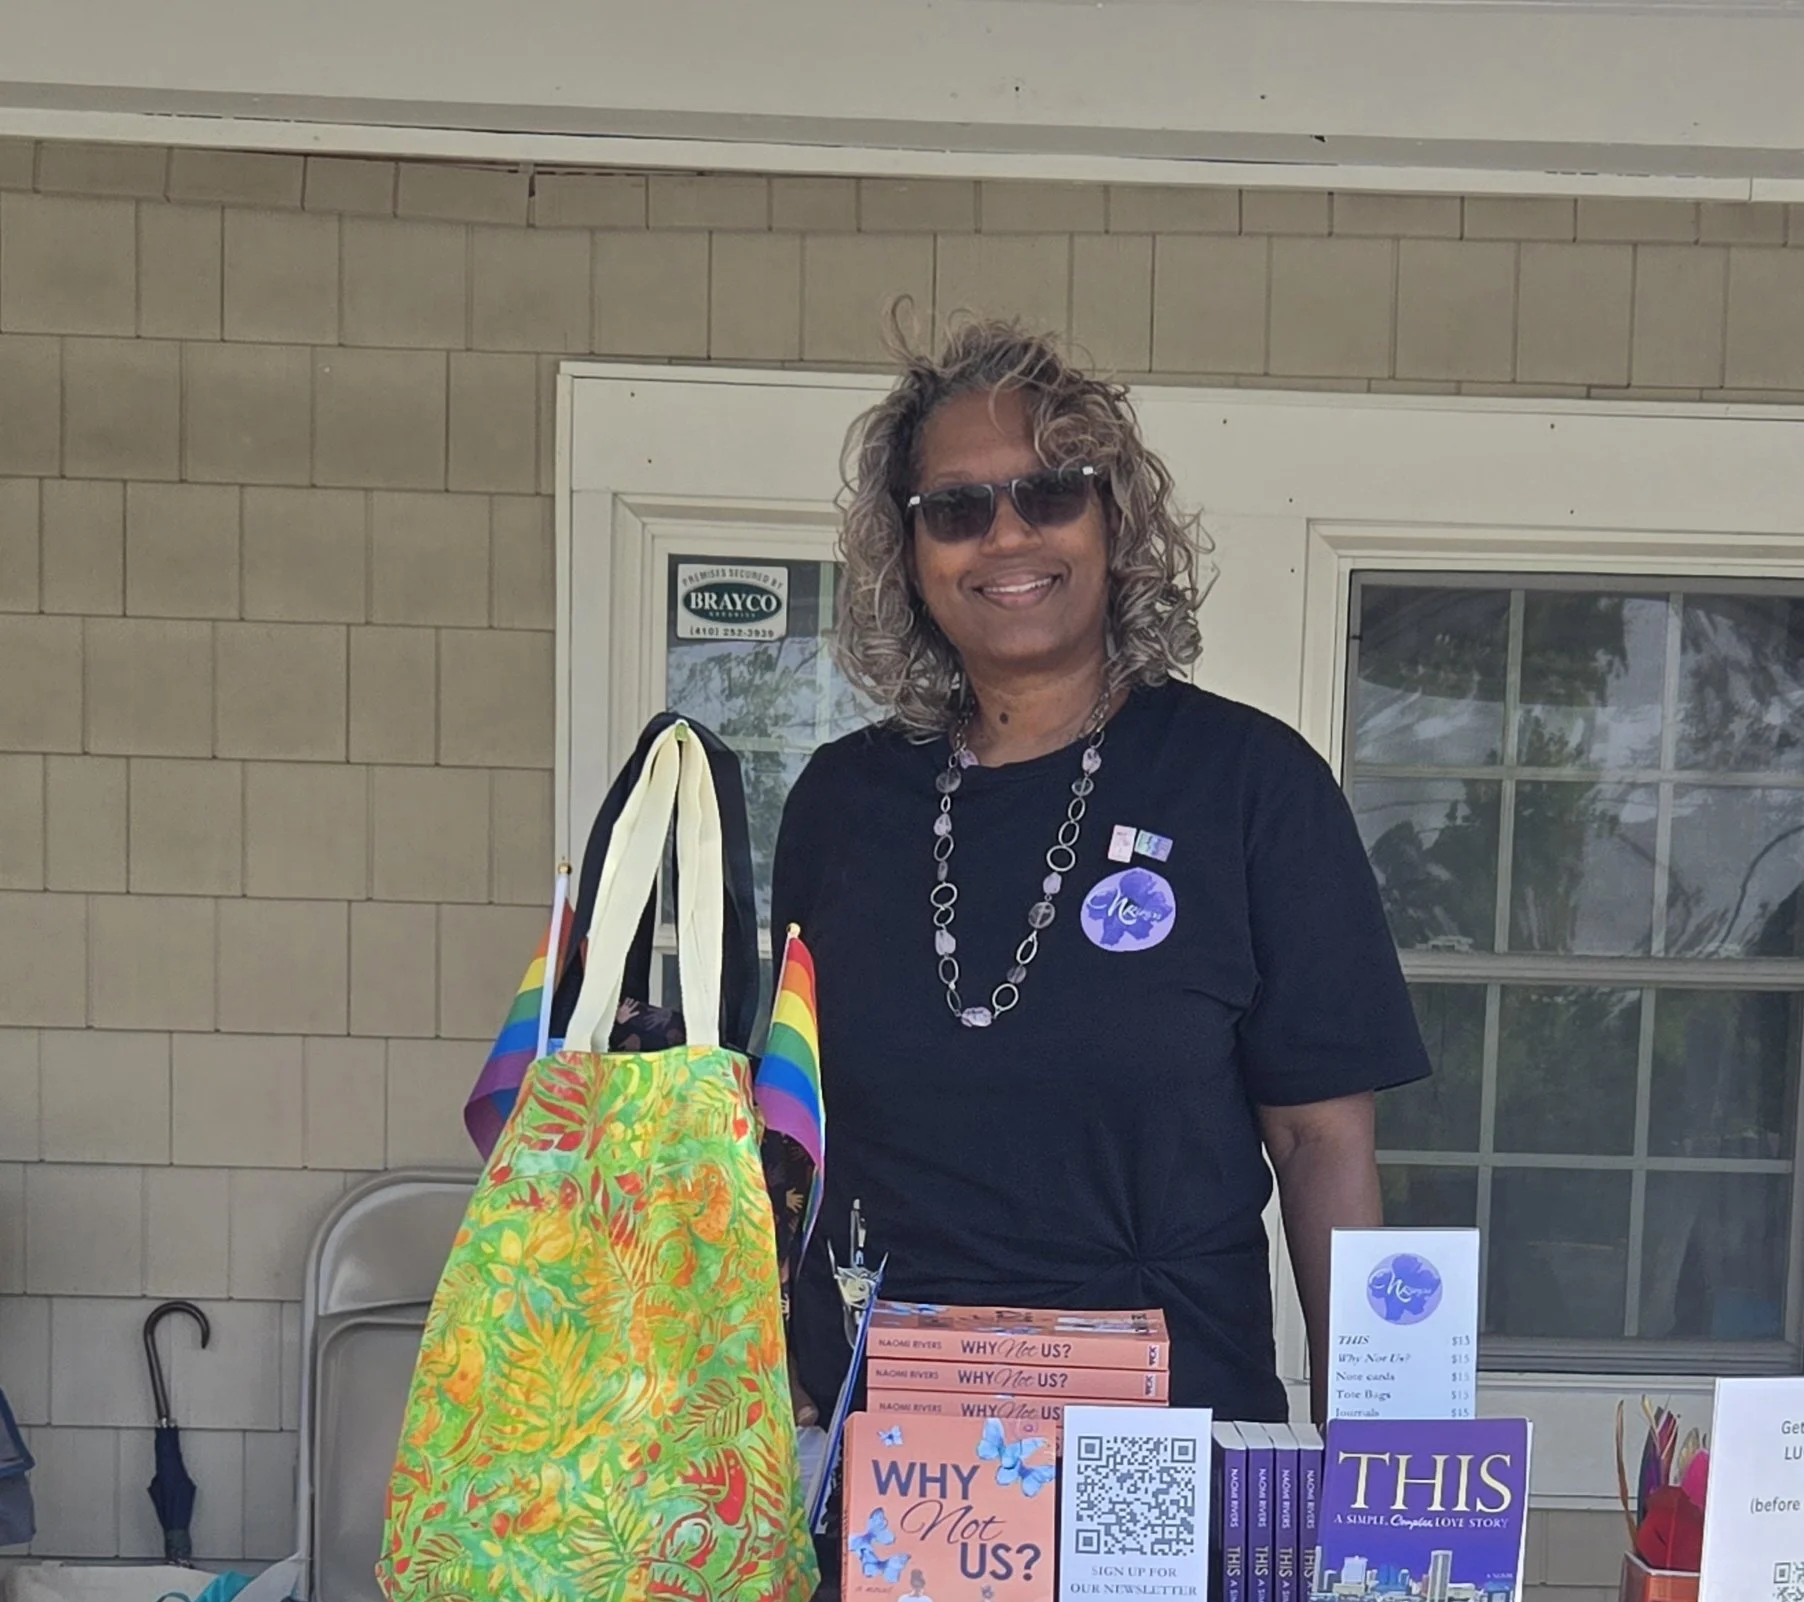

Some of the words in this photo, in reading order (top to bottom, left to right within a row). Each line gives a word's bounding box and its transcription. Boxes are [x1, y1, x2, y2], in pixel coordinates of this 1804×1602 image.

[682, 568, 727, 587] PREMISES
[728, 568, 770, 584] SECURED
[771, 578, 784, 590] BY
[690, 592, 777, 613] BRAYCO
[690, 626, 719, 636] (410)
[878, 1339, 910, 1348] NAOMI
[912, 1340, 942, 1349] RIVERS
[961, 1340, 997, 1355] WHY
[998, 1338, 1038, 1358] Not
[1041, 1343, 1072, 1359] US?
[1338, 1334, 1370, 1345] THIS
[1338, 1353, 1361, 1366] Why
[1364, 1353, 1387, 1363] Not
[875, 1369, 907, 1378] NAOMI
[910, 1370, 939, 1380] RIVERS
[958, 1370, 994, 1385] WHY
[994, 1367, 1034, 1388] Not
[1038, 1373, 1069, 1388] US?
[1336, 1371, 1363, 1381] Note
[1366, 1371, 1395, 1381] cards
[1336, 1389, 1361, 1399] Tote
[1364, 1389, 1391, 1402] Bags
[879, 1402, 911, 1411] NAOMI
[912, 1403, 942, 1413] RIVERS
[961, 1403, 997, 1417] WHY
[998, 1401, 1037, 1419] Not
[1041, 1405, 1063, 1420] US
[1335, 1407, 1380, 1417] Journals
[1784, 1446, 1804, 1460] LU
[871, 1459, 980, 1500] WHY
[1230, 1468, 1239, 1499] NAOMI
[1258, 1468, 1267, 1499] NAOMI
[1282, 1469, 1291, 1500] NAOMI
[1306, 1470, 1315, 1500] NAOMI
[1338, 1451, 1513, 1513] THIS
[1230, 1500, 1239, 1528] RIVERS
[1258, 1500, 1267, 1528] RIVERS
[1282, 1501, 1291, 1529] RIVERS
[1306, 1501, 1315, 1529] RIVERS
[1750, 1496, 1801, 1514] (before
[900, 1500, 1007, 1545] Not
[1334, 1514, 1342, 1524] A
[1435, 1516, 1465, 1528] LOVE
[1468, 1518, 1509, 1529] STORY
[959, 1541, 1041, 1581] US?
[1091, 1566, 1124, 1576] SIGN
[1128, 1567, 1146, 1577] UP
[1149, 1567, 1177, 1577] FOR
[1227, 1546, 1241, 1577] THIS
[1255, 1546, 1269, 1577] THIS
[1279, 1547, 1293, 1578] THIS
[1070, 1583, 1100, 1594] OUR
[1104, 1584, 1198, 1596] NEWSLETTER
[1230, 1579, 1238, 1587] A
[1258, 1579, 1266, 1587] A
[1282, 1580, 1290, 1589] A
